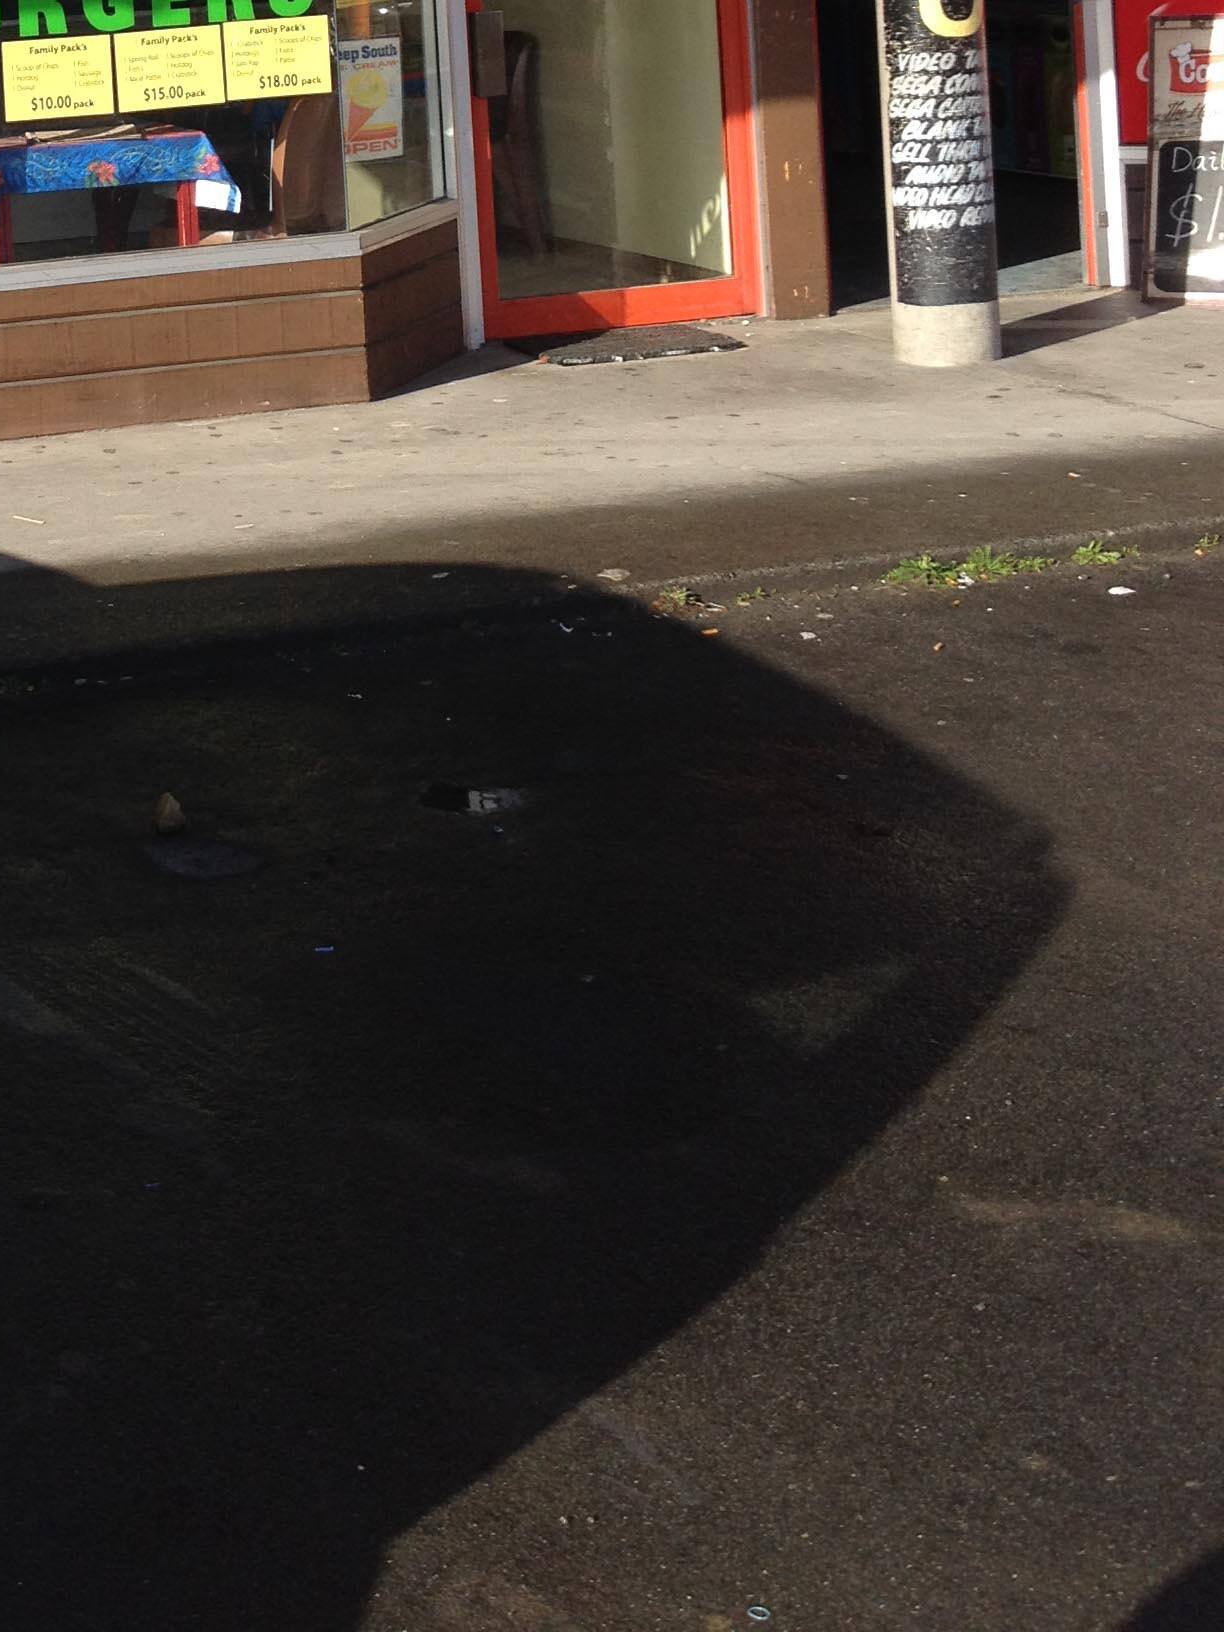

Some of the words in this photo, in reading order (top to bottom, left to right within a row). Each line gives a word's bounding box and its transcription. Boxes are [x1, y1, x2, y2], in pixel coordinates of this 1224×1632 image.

[249, 25, 278, 35] Family
[280, 24, 306, 33] Pack's
[140, 36, 170, 46] Family
[171, 34, 198, 43] Pack's
[29, 45, 59, 55] Family
[61, 43, 88, 52] Pack's
[338, 49, 359, 63] eep
[361, 45, 398, 59] South
[898, 52, 956, 72] VIDEO
[259, 73, 298, 89] $18.00
[301, 76, 322, 87] pack
[892, 74, 942, 97] SEGA
[143, 85, 184, 102] $15.00
[185, 89, 206, 100] pack
[31, 95, 72, 111] $10.00
[73, 99, 94, 110] pack
[889, 97, 936, 119] SEGA
[1165, 185, 1224, 247] $1.
